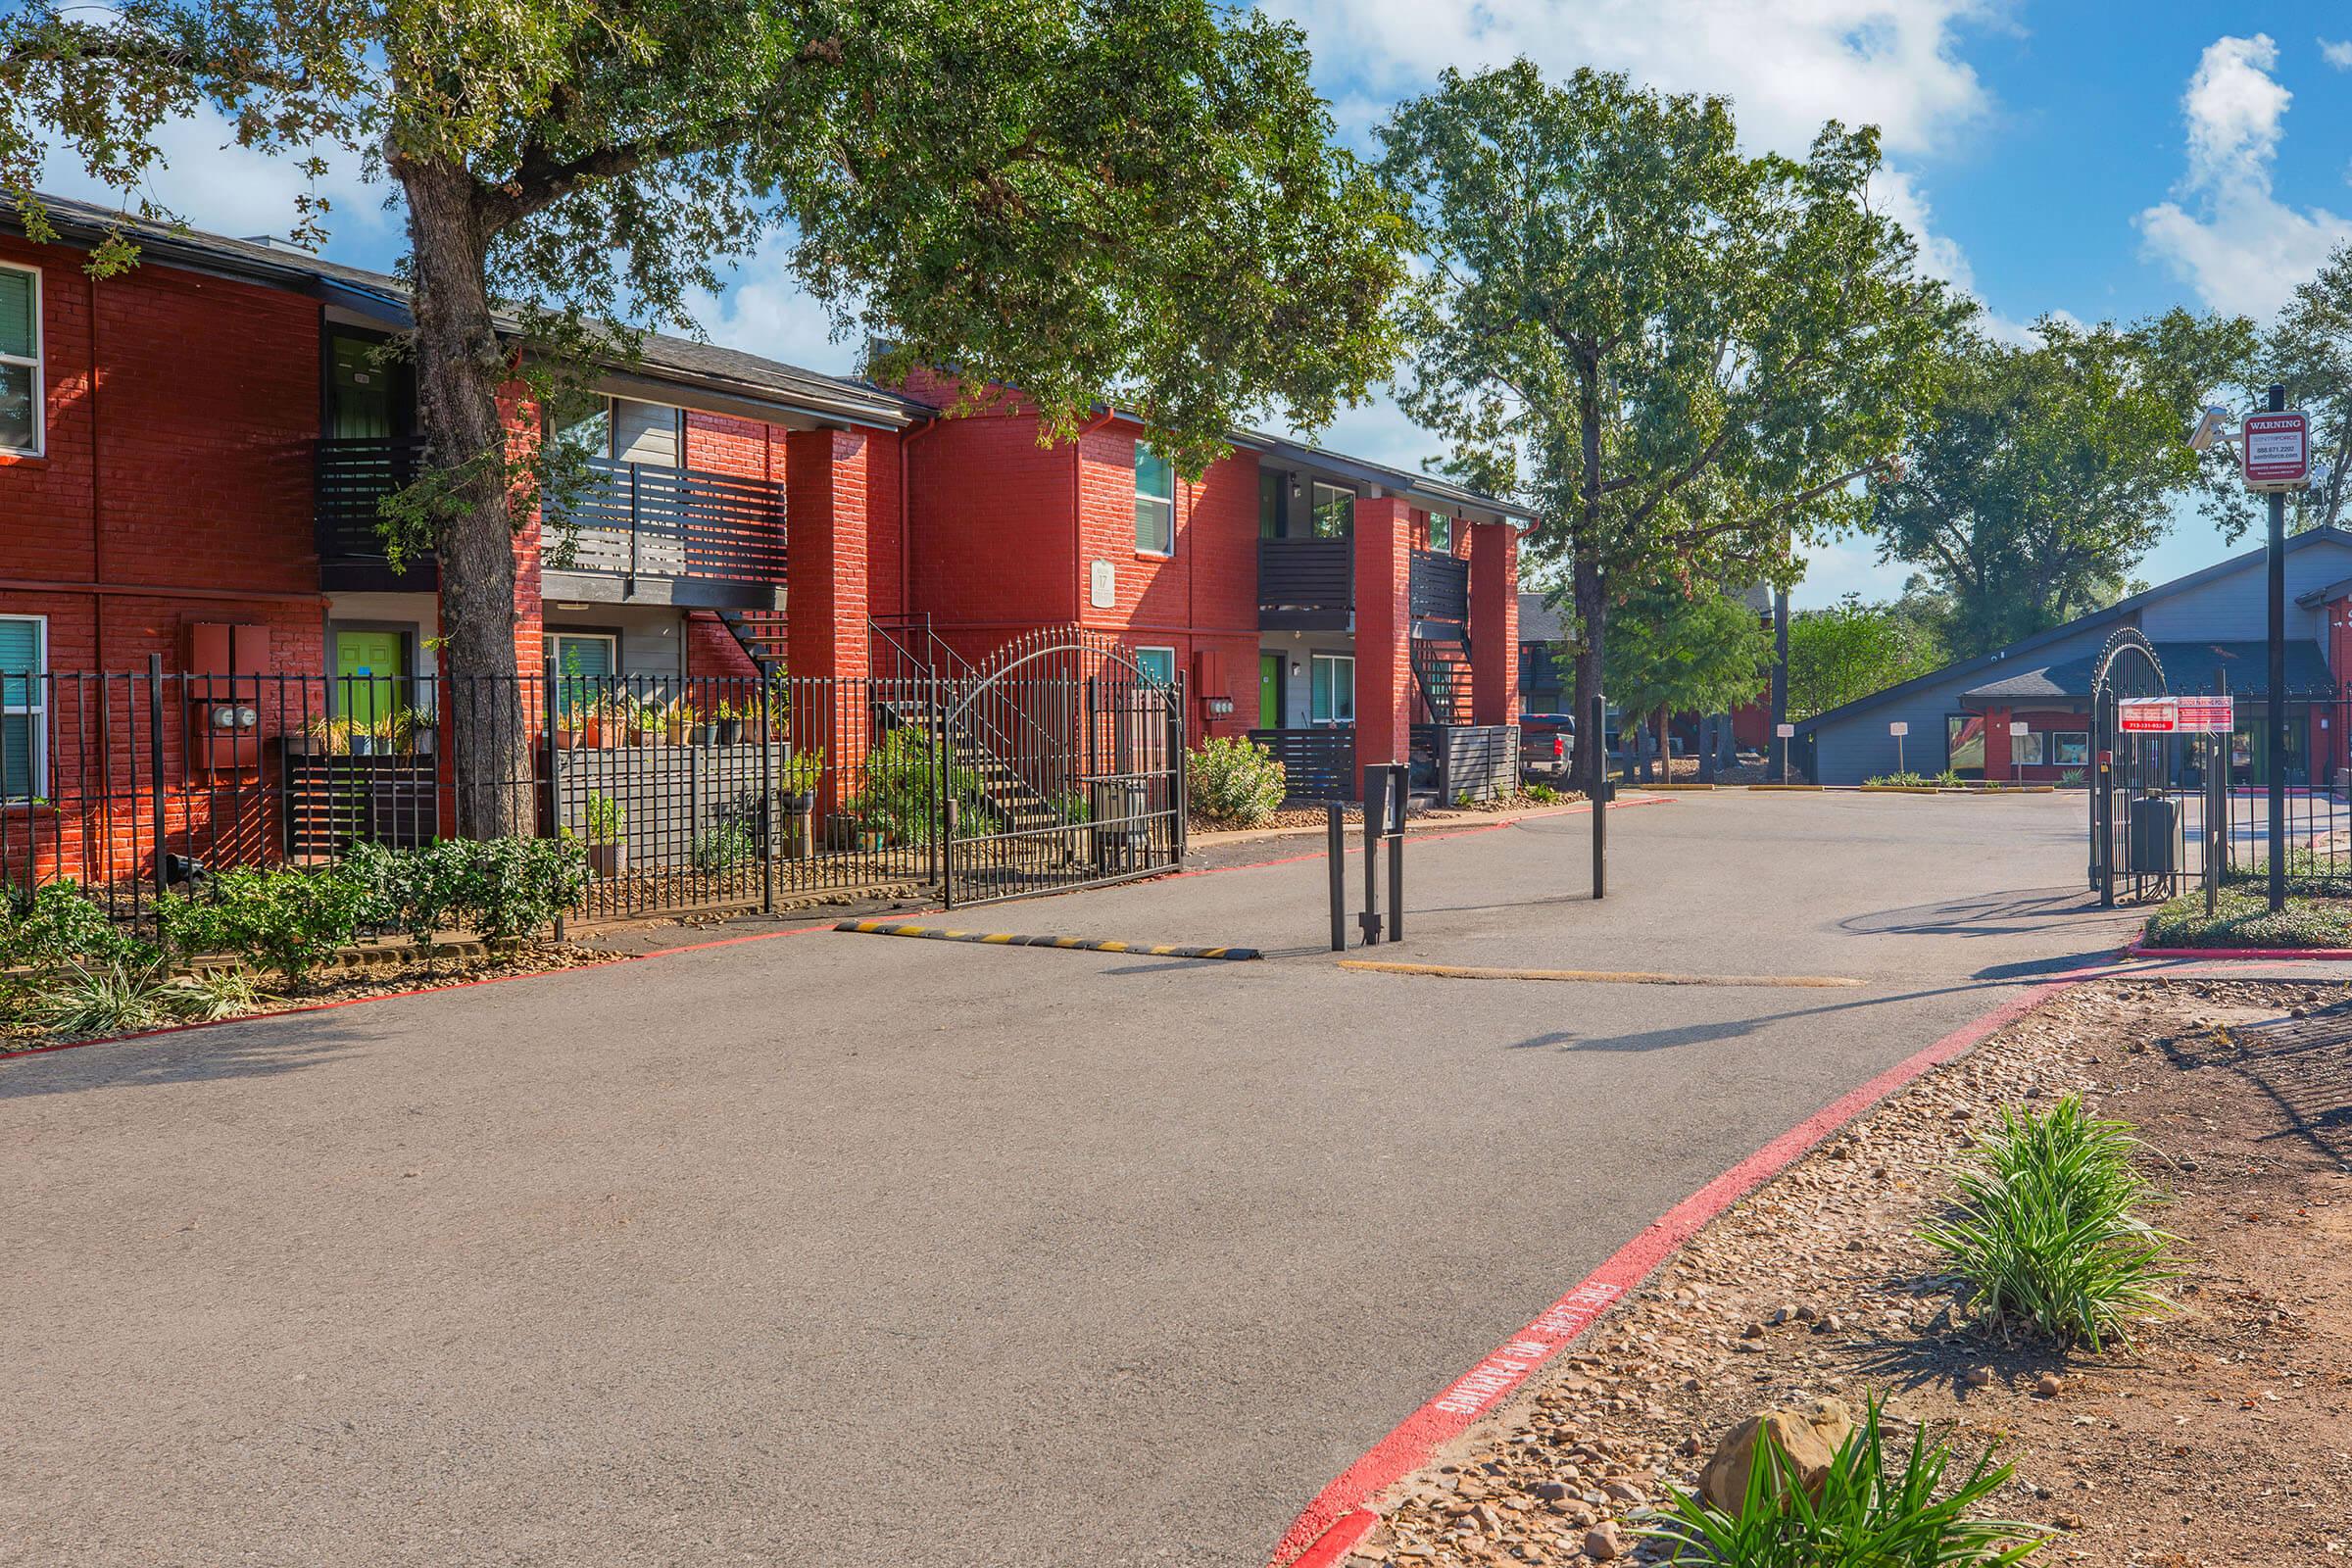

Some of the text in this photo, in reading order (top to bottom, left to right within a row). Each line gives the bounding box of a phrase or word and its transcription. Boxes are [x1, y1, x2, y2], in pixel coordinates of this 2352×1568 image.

[2250, 419, 2301, 429] WARNING
[1502, 1340, 1552, 1358] NO
[1435, 1357, 1529, 1415] PARKING
